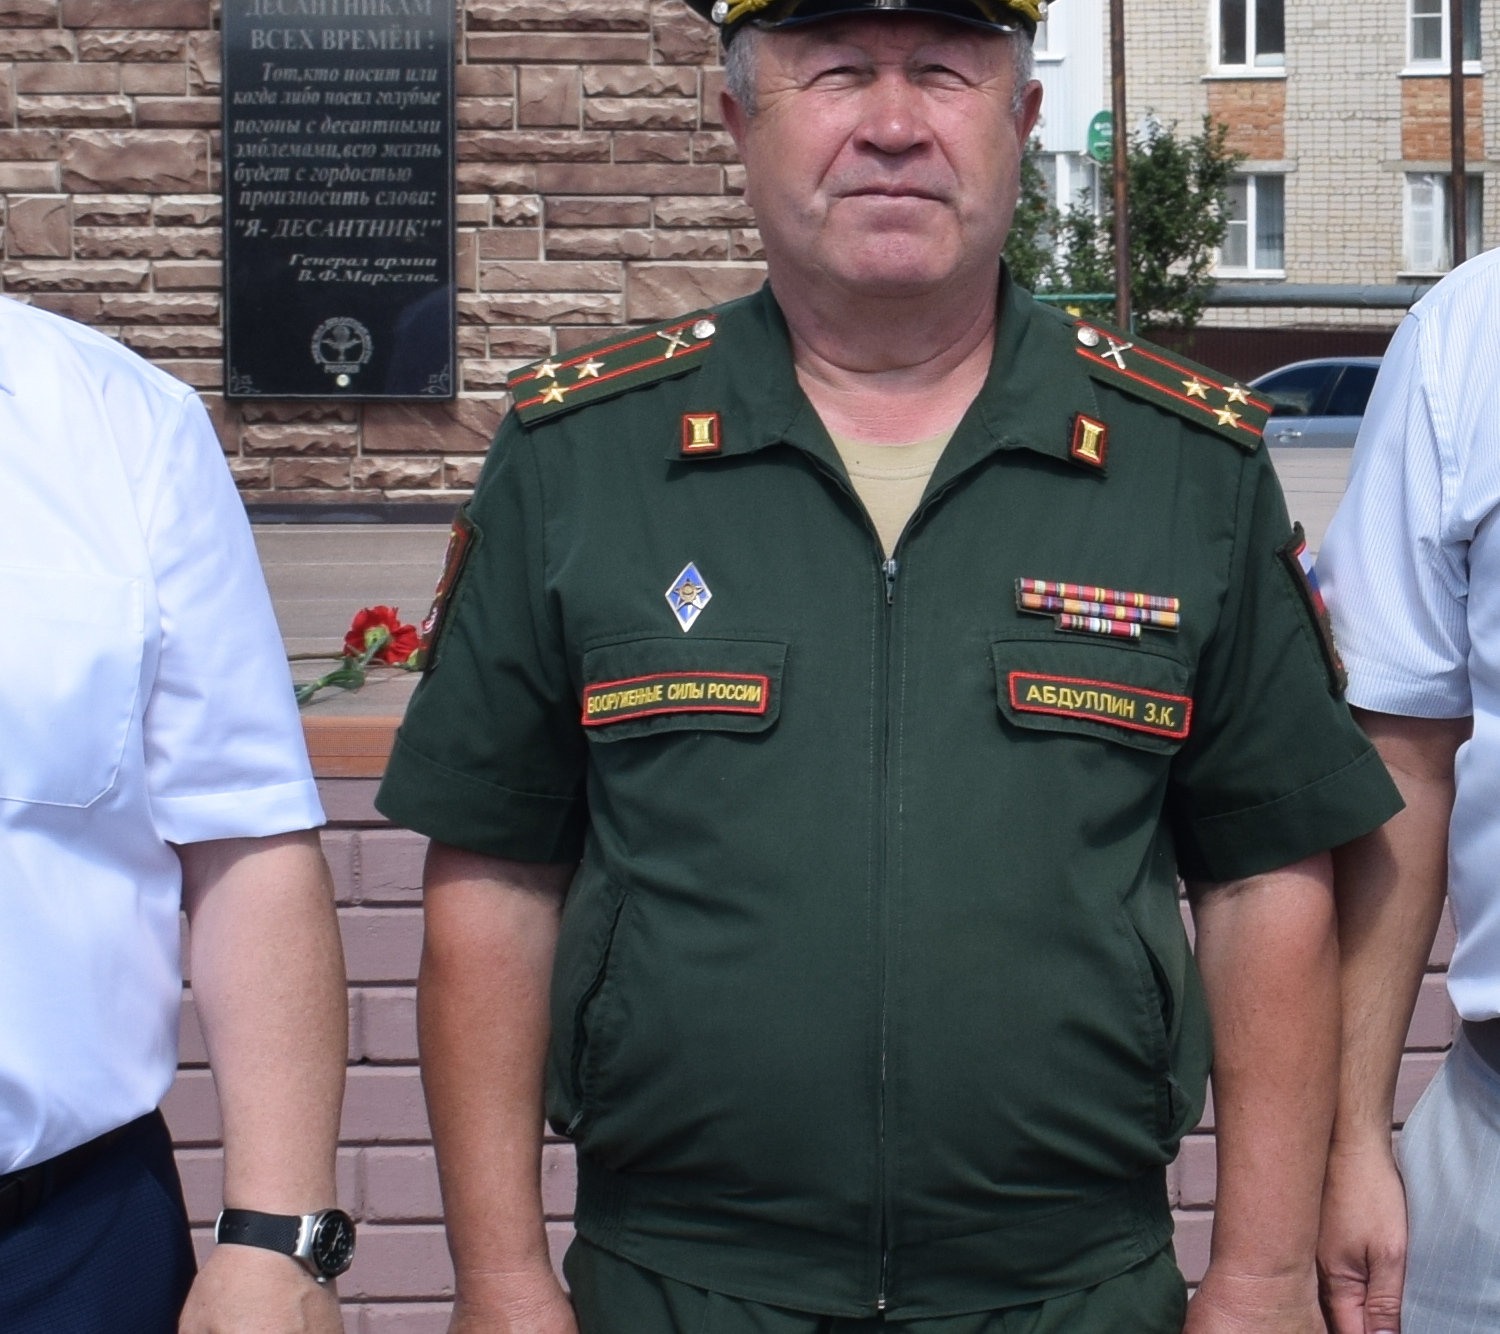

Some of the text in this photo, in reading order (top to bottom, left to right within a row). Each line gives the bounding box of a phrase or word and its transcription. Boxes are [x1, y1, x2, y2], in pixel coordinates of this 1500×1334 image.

[251, 29, 314, 50] ВСЕХ
[344, 67, 400, 82] носит
[405, 67, 439, 82] или
[280, 86, 321, 105] либо
[324, 90, 372, 105] носил
[376, 86, 442, 110] голубые
[233, 115, 441, 134] погоны с десантными
[381, 143, 442, 158] жизнь
[233, 162, 412, 187] будет с гордостью
[239, 190, 438, 211] произносить слова:
[289, 253, 438, 270] Генерал армии
[587, 682, 762, 714] ВООРУЖЕННЫЕ СИЛЫ РОССИИ
[1026, 684, 1176, 727] АБДУЛЛИН З.К.
